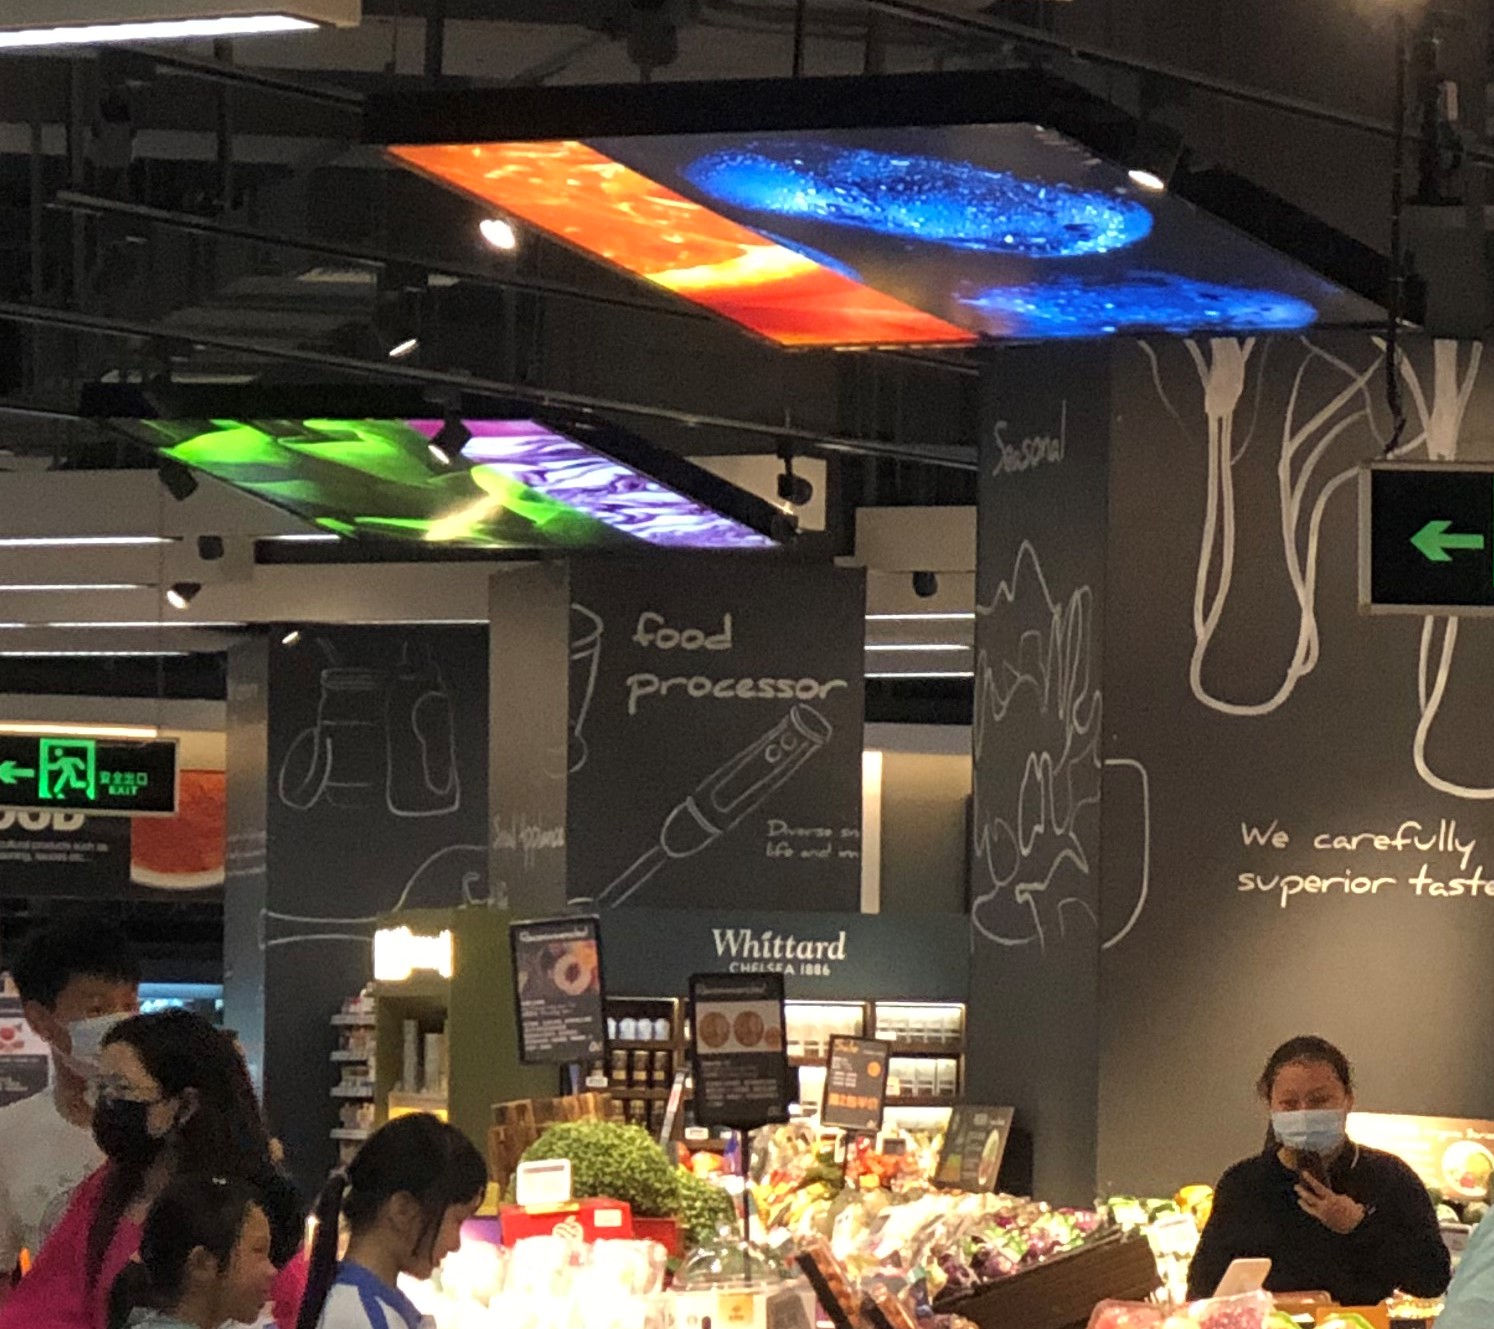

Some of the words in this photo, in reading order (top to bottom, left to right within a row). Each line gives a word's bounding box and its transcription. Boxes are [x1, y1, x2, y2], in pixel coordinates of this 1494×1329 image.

[632, 612, 732, 650] food
[626, 673, 848, 715] processor
[100, 771, 148, 785] 安全出口
[108, 785, 138, 796] EXIT
[1241, 819, 1290, 849] We
[1313, 818, 1477, 871] carefully
[1237, 868, 1398, 909] superior
[712, 928, 847, 960] Whittard
[728, 961, 795, 976] CHELSEA
[800, 963, 832, 976] 1886
